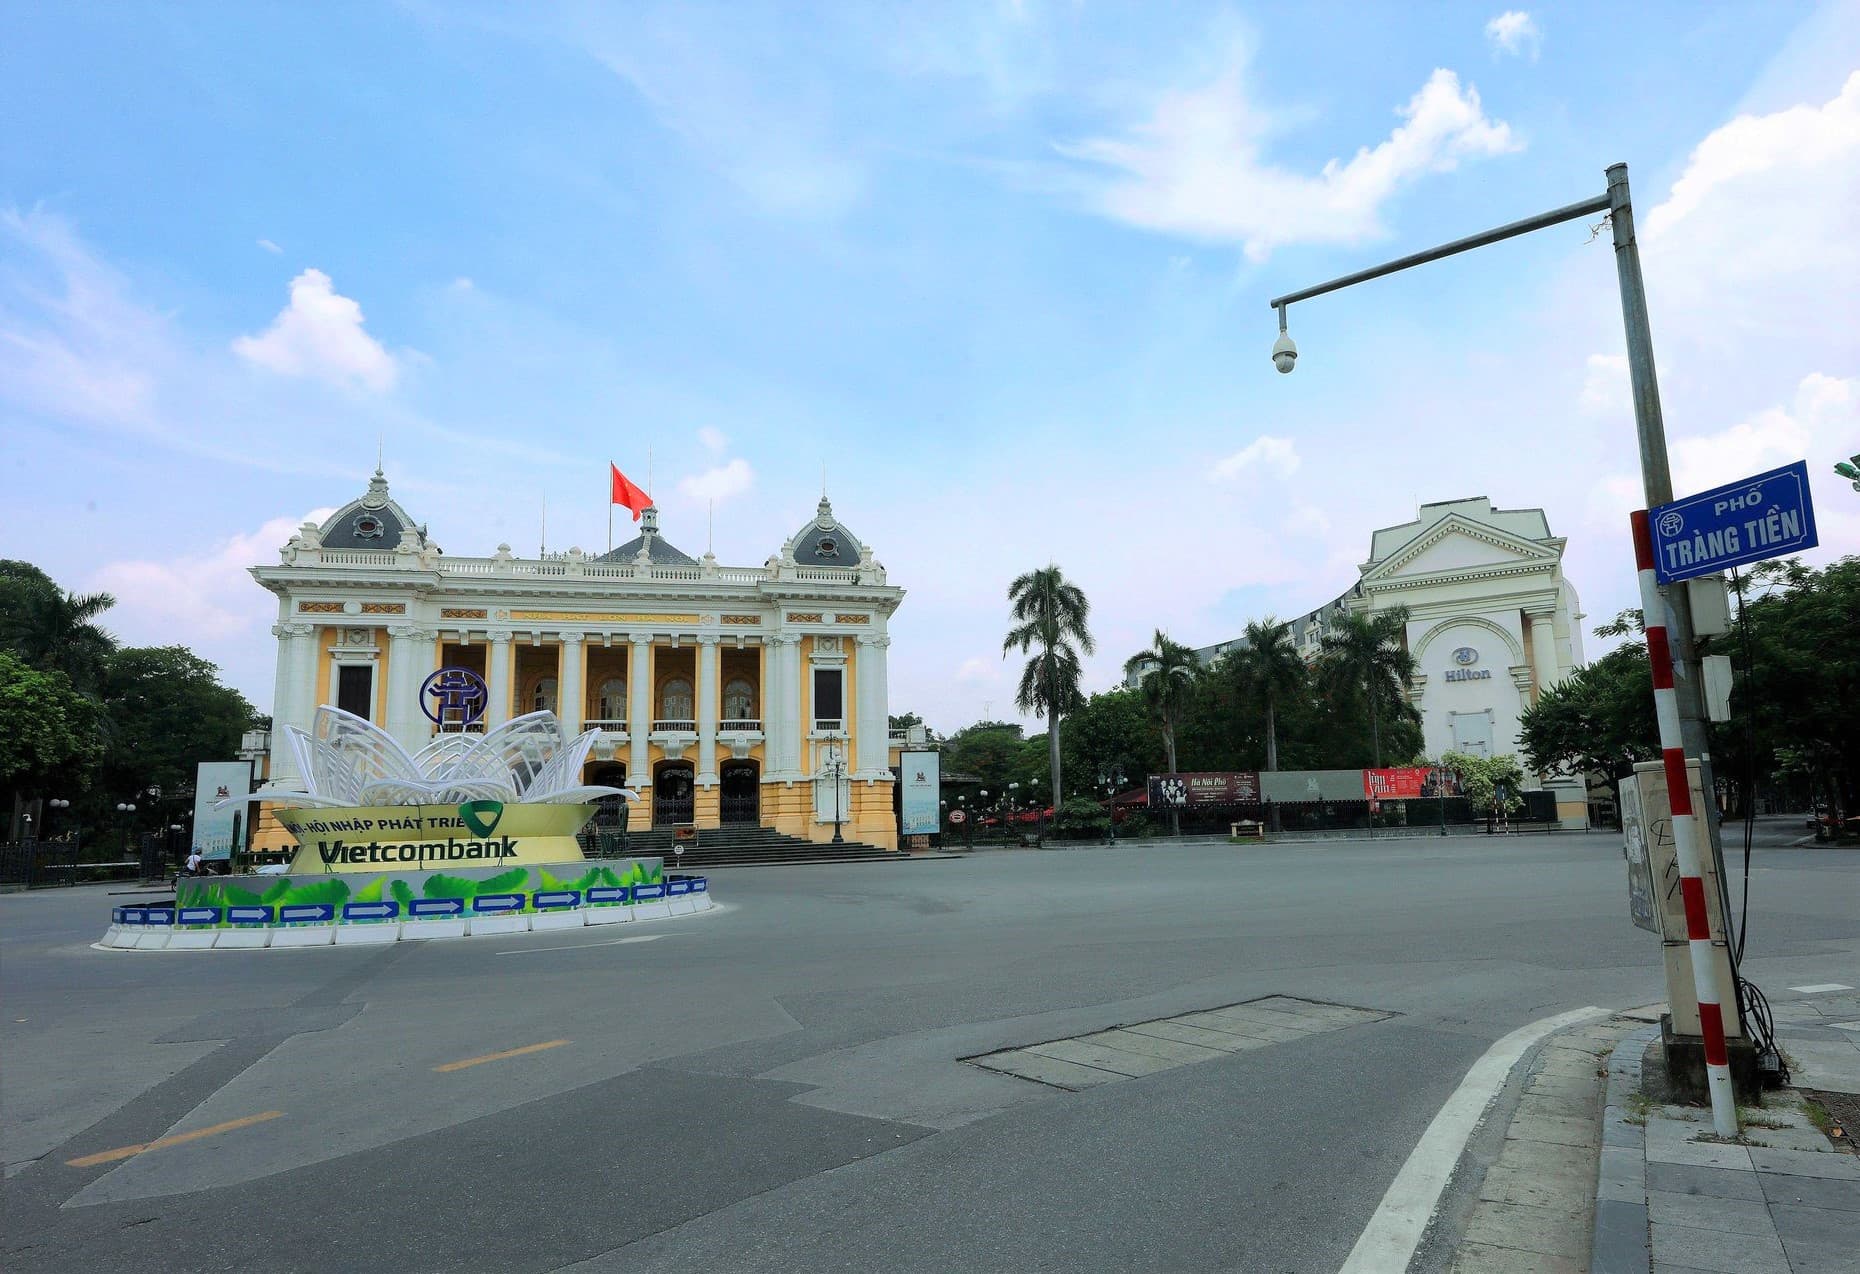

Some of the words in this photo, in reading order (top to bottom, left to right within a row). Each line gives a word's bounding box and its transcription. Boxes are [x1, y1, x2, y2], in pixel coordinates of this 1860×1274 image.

[1714, 484, 1764, 516] PHỐ
[1665, 526, 1740, 569] TRÀNG
[1744, 504, 1800, 549] TIỀN
[1444, 668, 1492, 682] Hilton
[330, 817, 374, 834] NHẬP
[377, 816, 424, 830] PHÁT
[318, 835, 519, 864] Vietcombank
